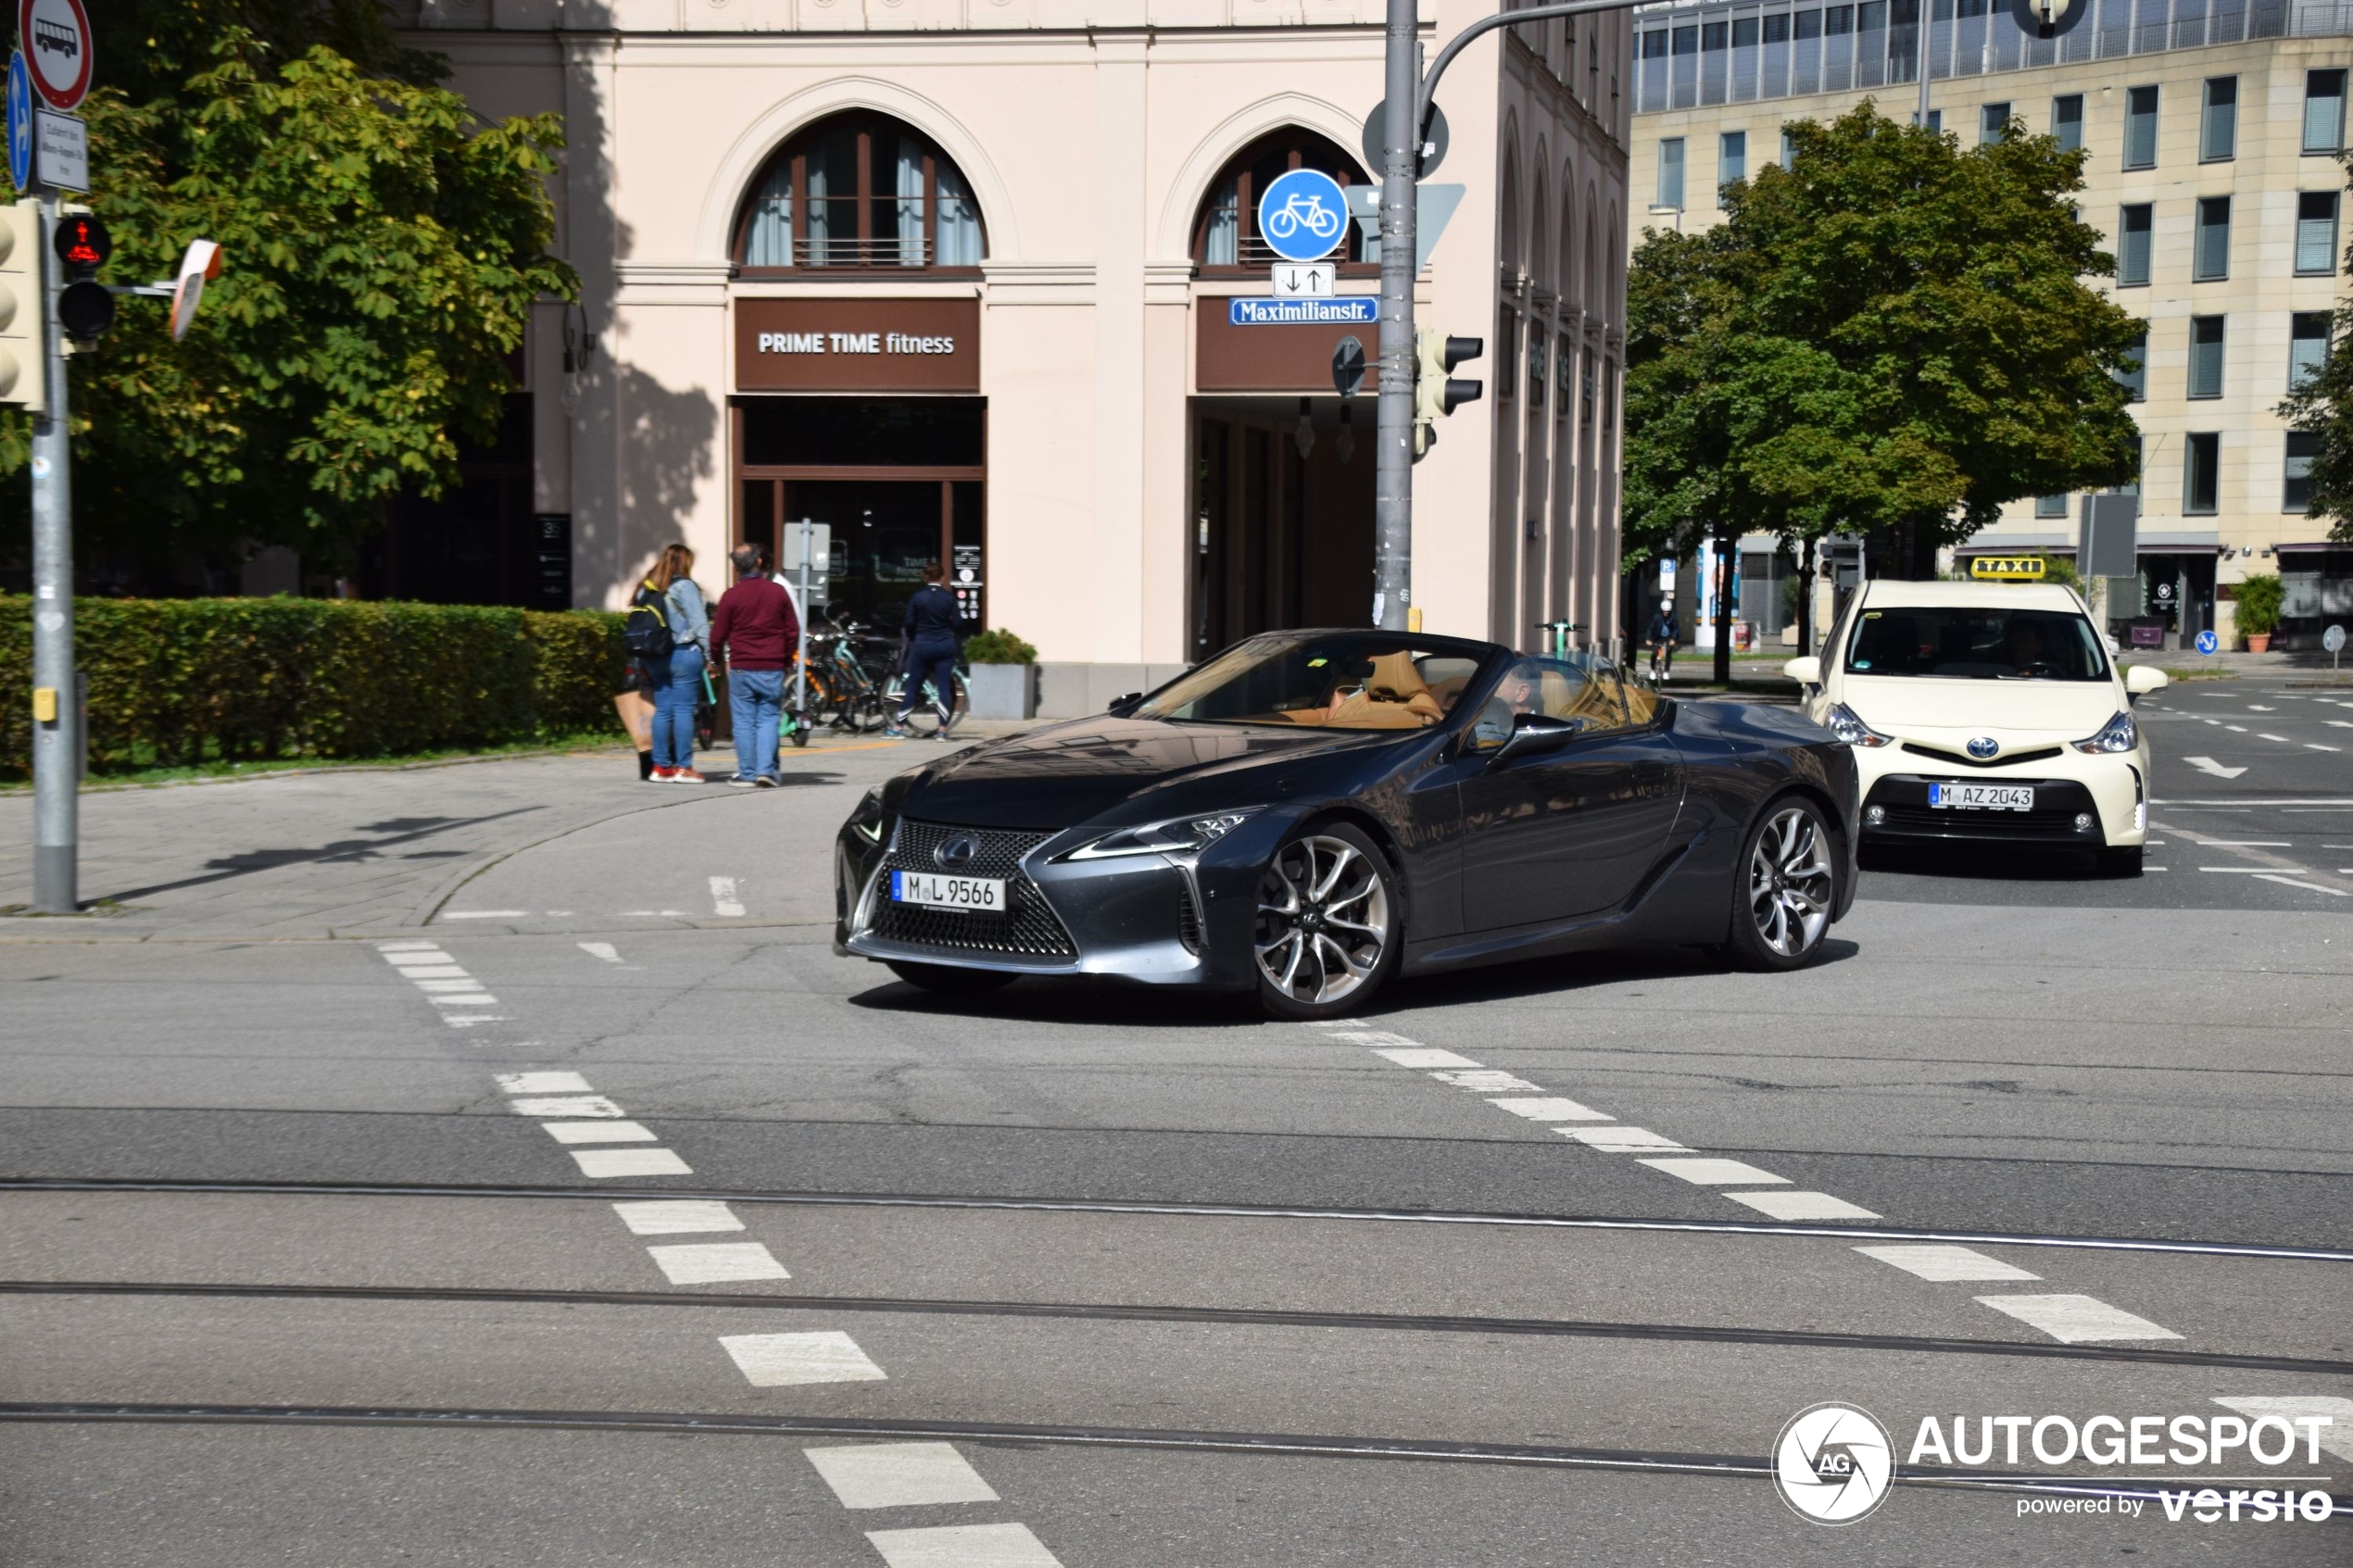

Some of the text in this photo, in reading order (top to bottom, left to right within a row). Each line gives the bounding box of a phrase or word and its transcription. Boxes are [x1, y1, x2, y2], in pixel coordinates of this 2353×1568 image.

[1240, 302, 1368, 321] Maximilianstr.
[759, 332, 954, 354] PRIME TIME fitness
[1984, 561, 2033, 572] TAXI
[1940, 787, 2031, 805] M AZ 2043
[909, 876, 994, 906] M L 9566
